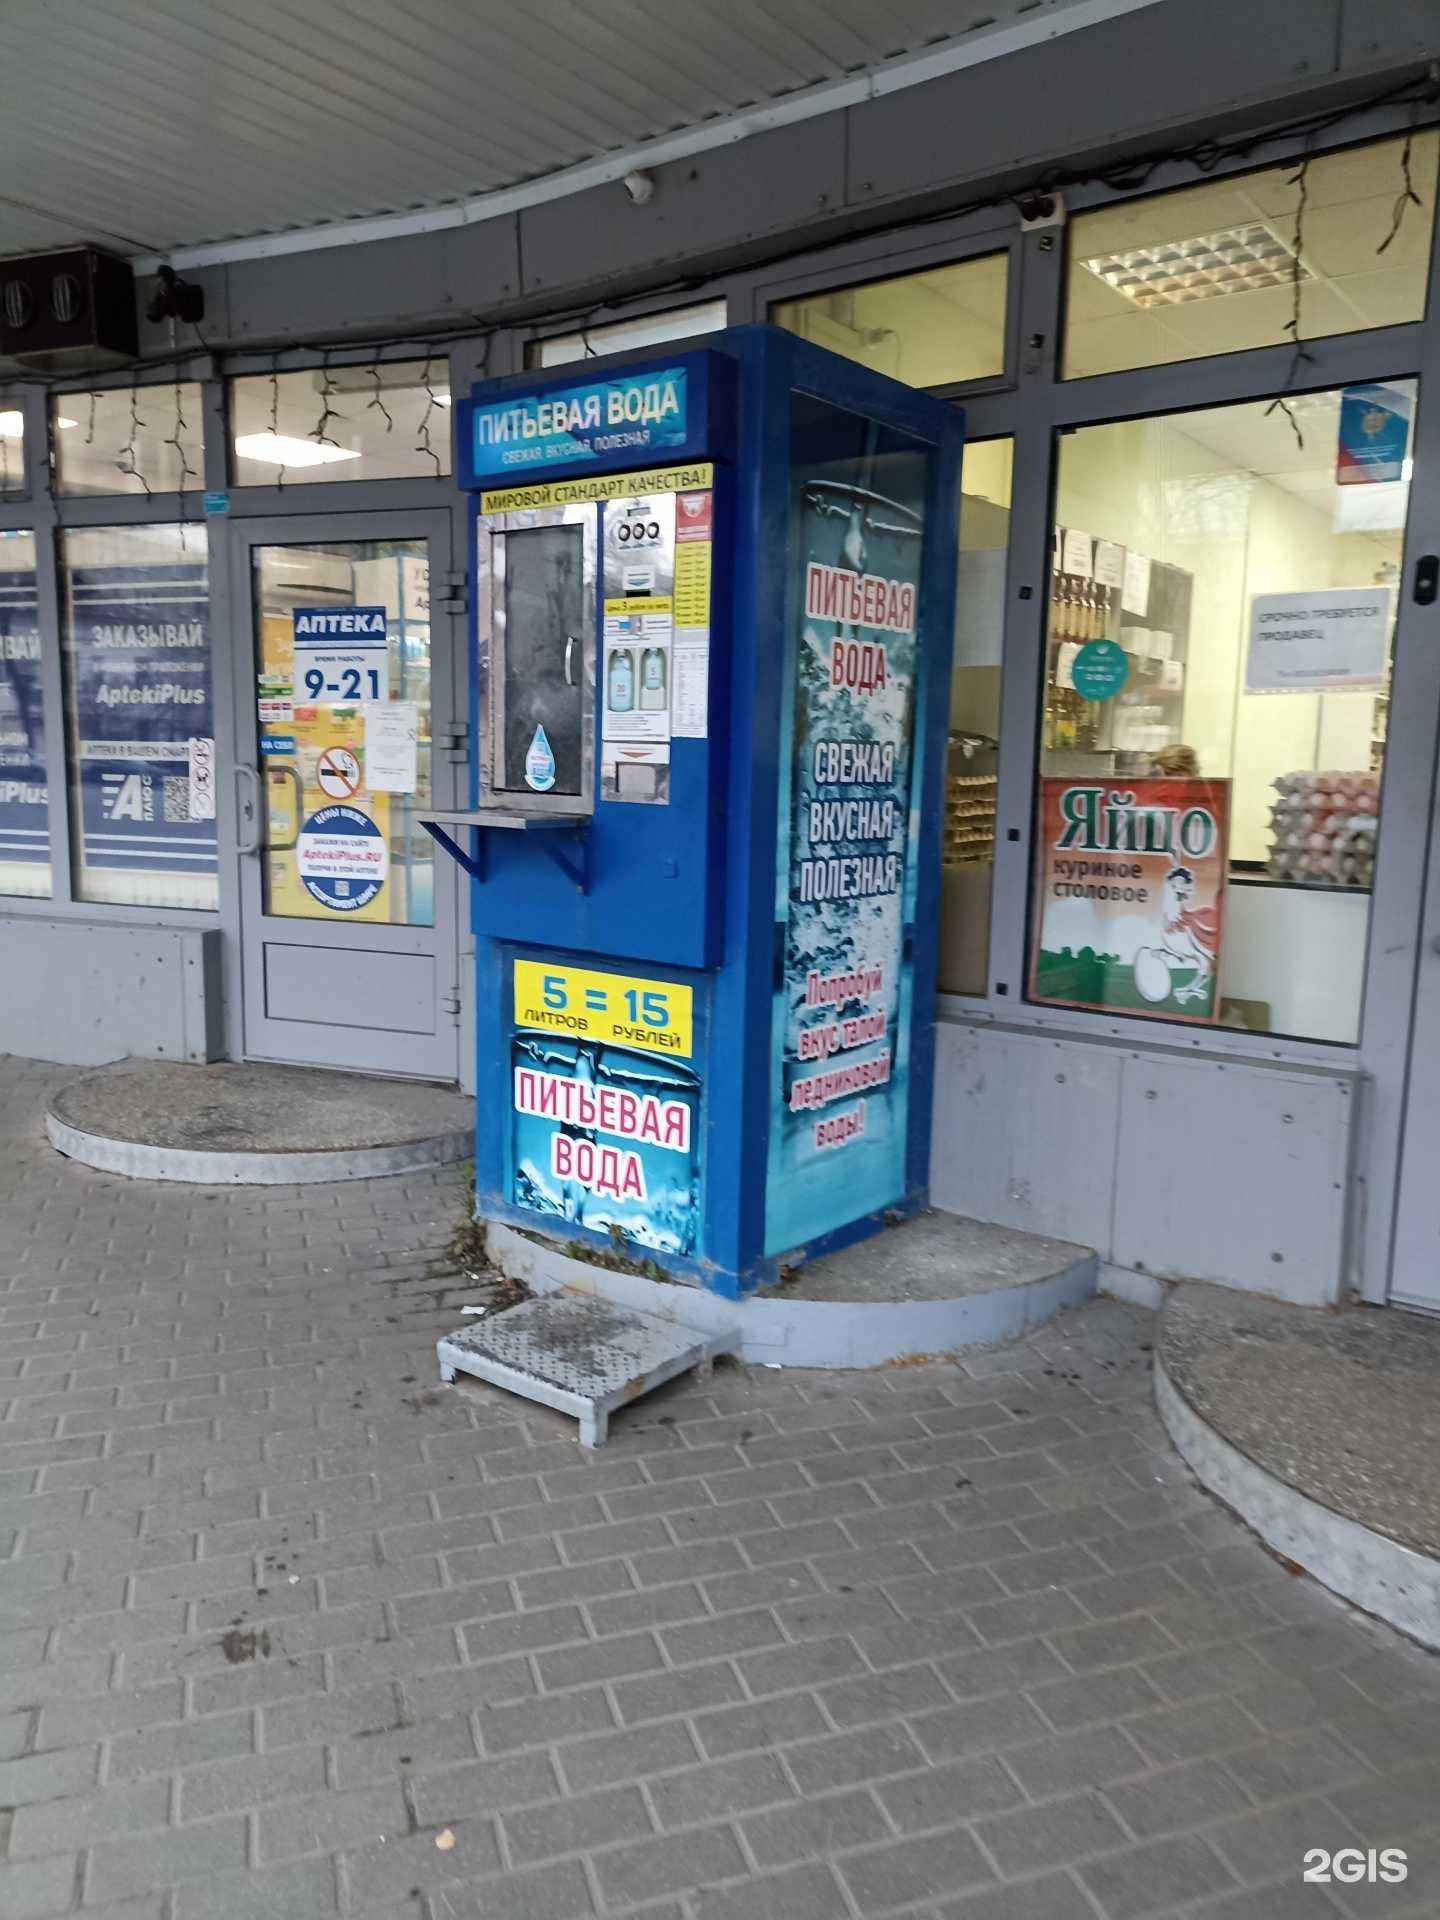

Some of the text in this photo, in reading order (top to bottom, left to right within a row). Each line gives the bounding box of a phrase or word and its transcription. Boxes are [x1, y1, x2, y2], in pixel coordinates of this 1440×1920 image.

[478, 380, 679, 446] ПИТЬЕВАЯ ВОДА
[485, 468, 708, 511] МИРОВОЙ СТАНДАРТ КАЧЕСТВА!
[807, 565, 914, 631] ПИТЬЕВАЯ
[91, 618, 203, 649] ЗАКАЗЫВАЙ
[296, 614, 386, 634] АПТЕКА
[304, 669, 380, 700] 9-21
[830, 639, 887, 698] ВОДА
[813, 741, 894, 784] СВЕЖАЯ
[809, 799, 894, 843] ВКУСНАЯ
[1056, 787, 1217, 860] Яйцо
[799, 855, 897, 901] ПОЛЕЗНАЯ
[1053, 859, 1144, 880] куриное
[1053, 881, 1149, 903] столовое
[543, 974, 569, 1010] 5
[624, 987, 670, 1029] 15
[523, 1008, 682, 1050] ЛИТРОВ РУБЛЕЙ
[518, 1070, 686, 1149] ПИТЬЕВАЯ
[555, 1136, 644, 1199] ВОДА
